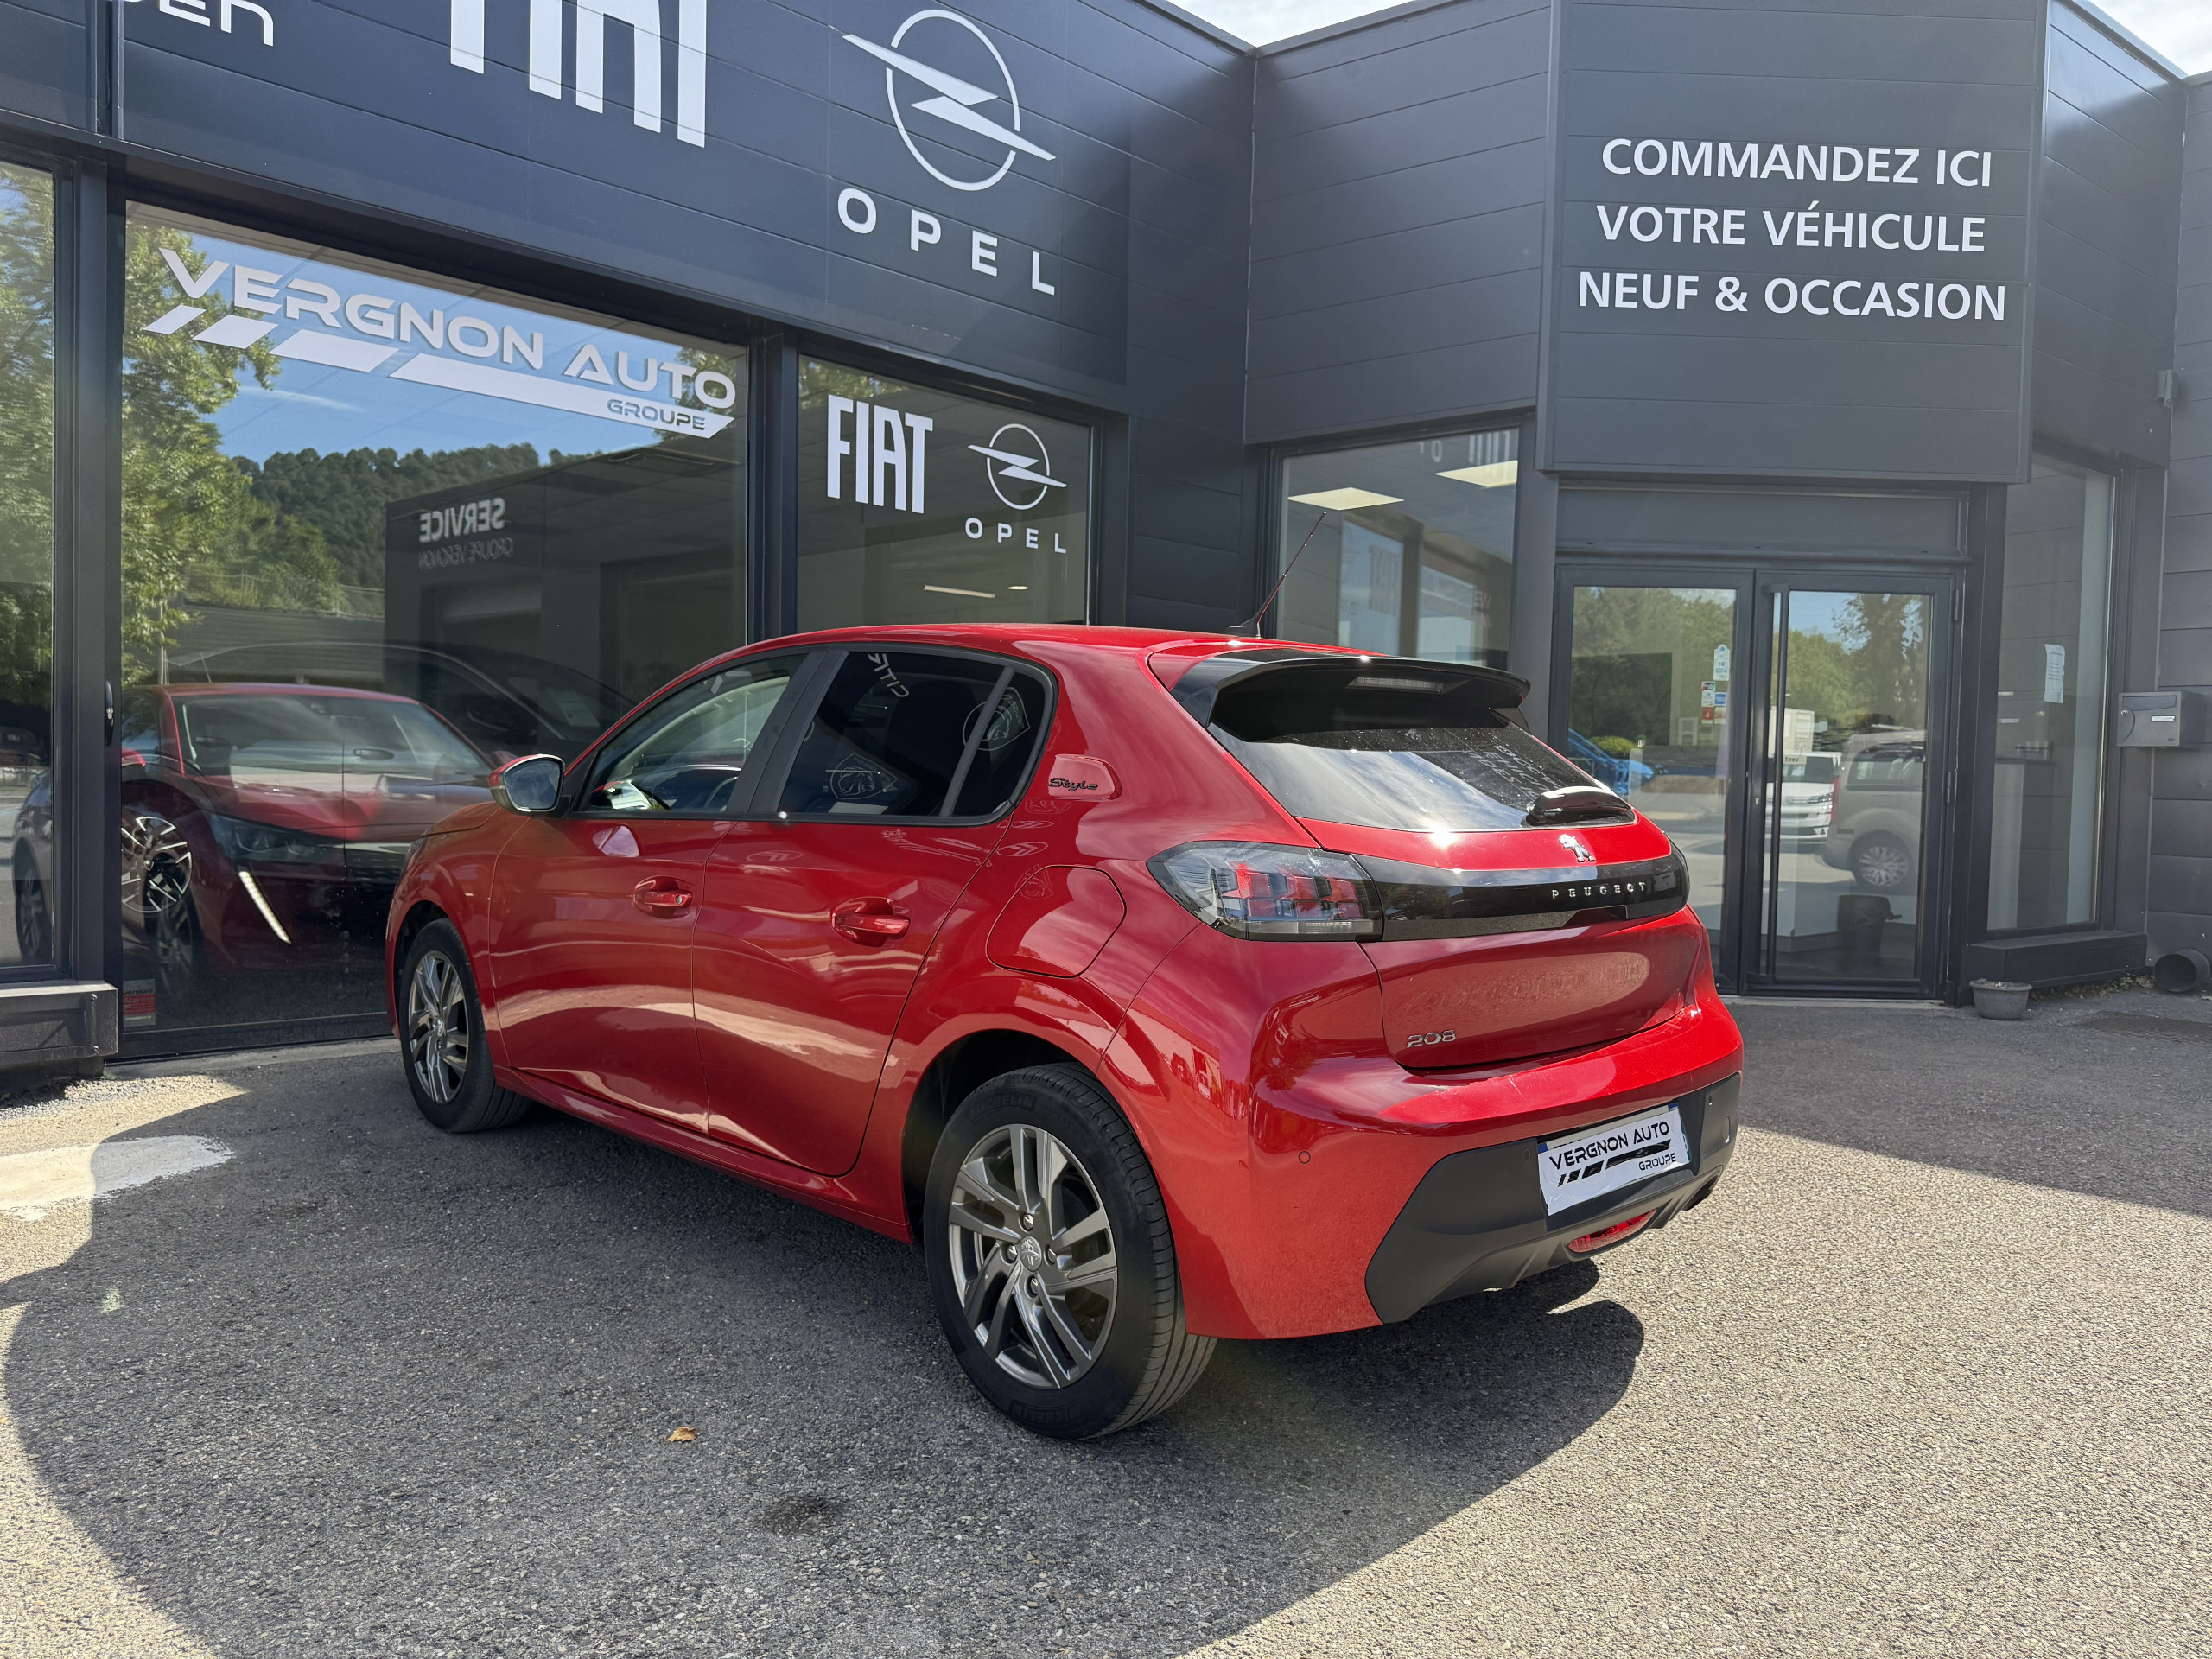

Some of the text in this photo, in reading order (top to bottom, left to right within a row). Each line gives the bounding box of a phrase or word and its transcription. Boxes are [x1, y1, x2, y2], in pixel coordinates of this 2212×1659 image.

[1602, 138, 1992, 188] COMMANDEZ ICI
[837, 188, 1055, 296] OPEL
[1596, 200, 1986, 252] VOTRE VÉHICULE
[1579, 271, 2005, 321] NEUF & OCCASION
[158, 247, 736, 410] VERGNON AUTO
[607, 398, 706, 432] GROUPE
[827, 394, 933, 514] FIAT
[965, 517, 1067, 554] OPEL
[1048, 778, 1098, 791] Style
[1551, 881, 1646, 899] PEUGEOT
[1407, 1029, 1456, 1049] 208
[1548, 1121, 1669, 1170] VERGNON AUTO
[1638, 1153, 1677, 1172] GROUPE
